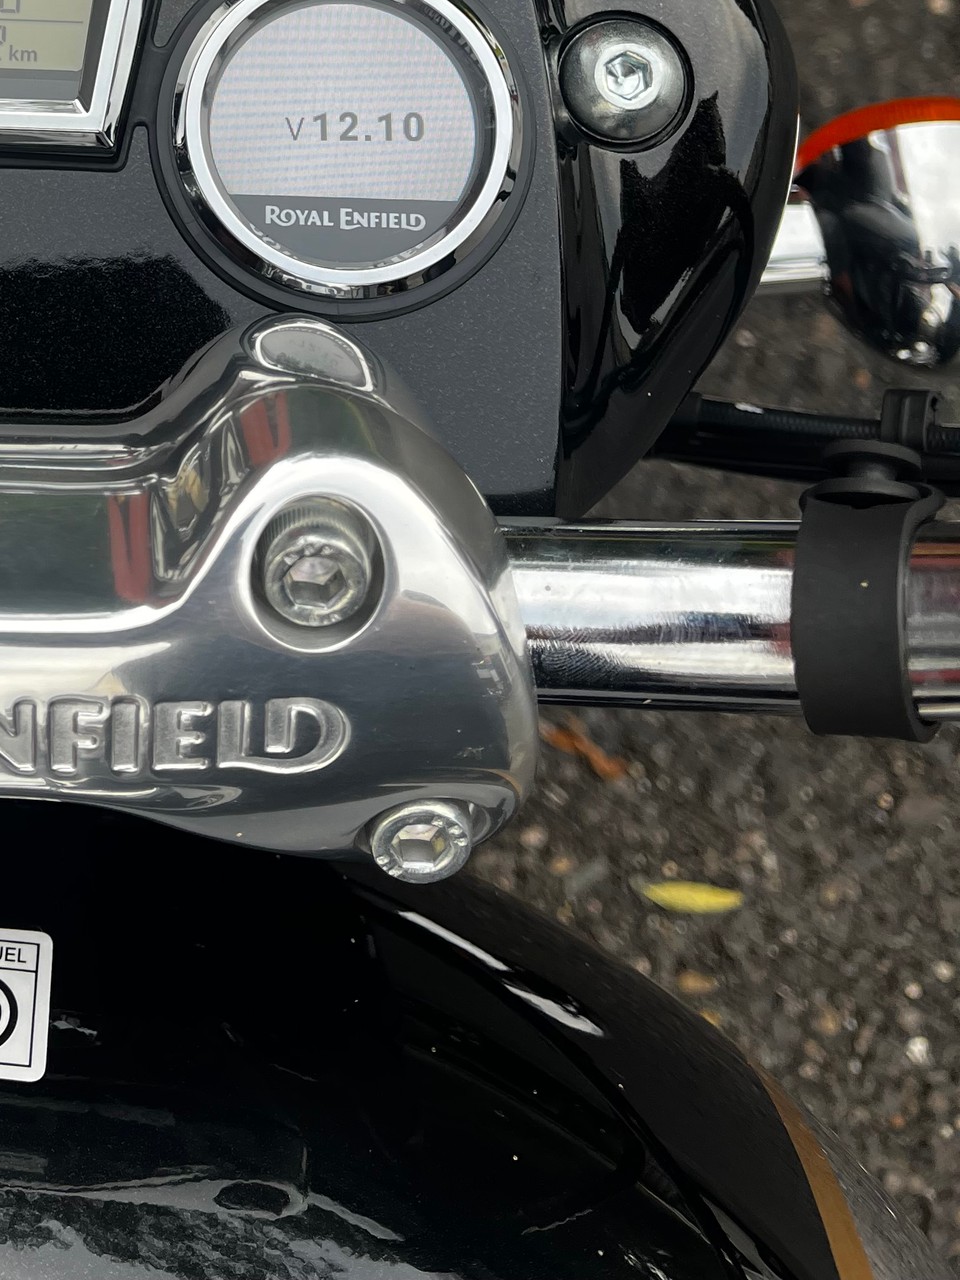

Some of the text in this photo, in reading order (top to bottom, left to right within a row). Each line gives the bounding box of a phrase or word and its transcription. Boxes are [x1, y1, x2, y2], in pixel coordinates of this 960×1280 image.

[9, 45, 38, 62] km
[265, 205, 426, 231] ROYAL ENFIELD
